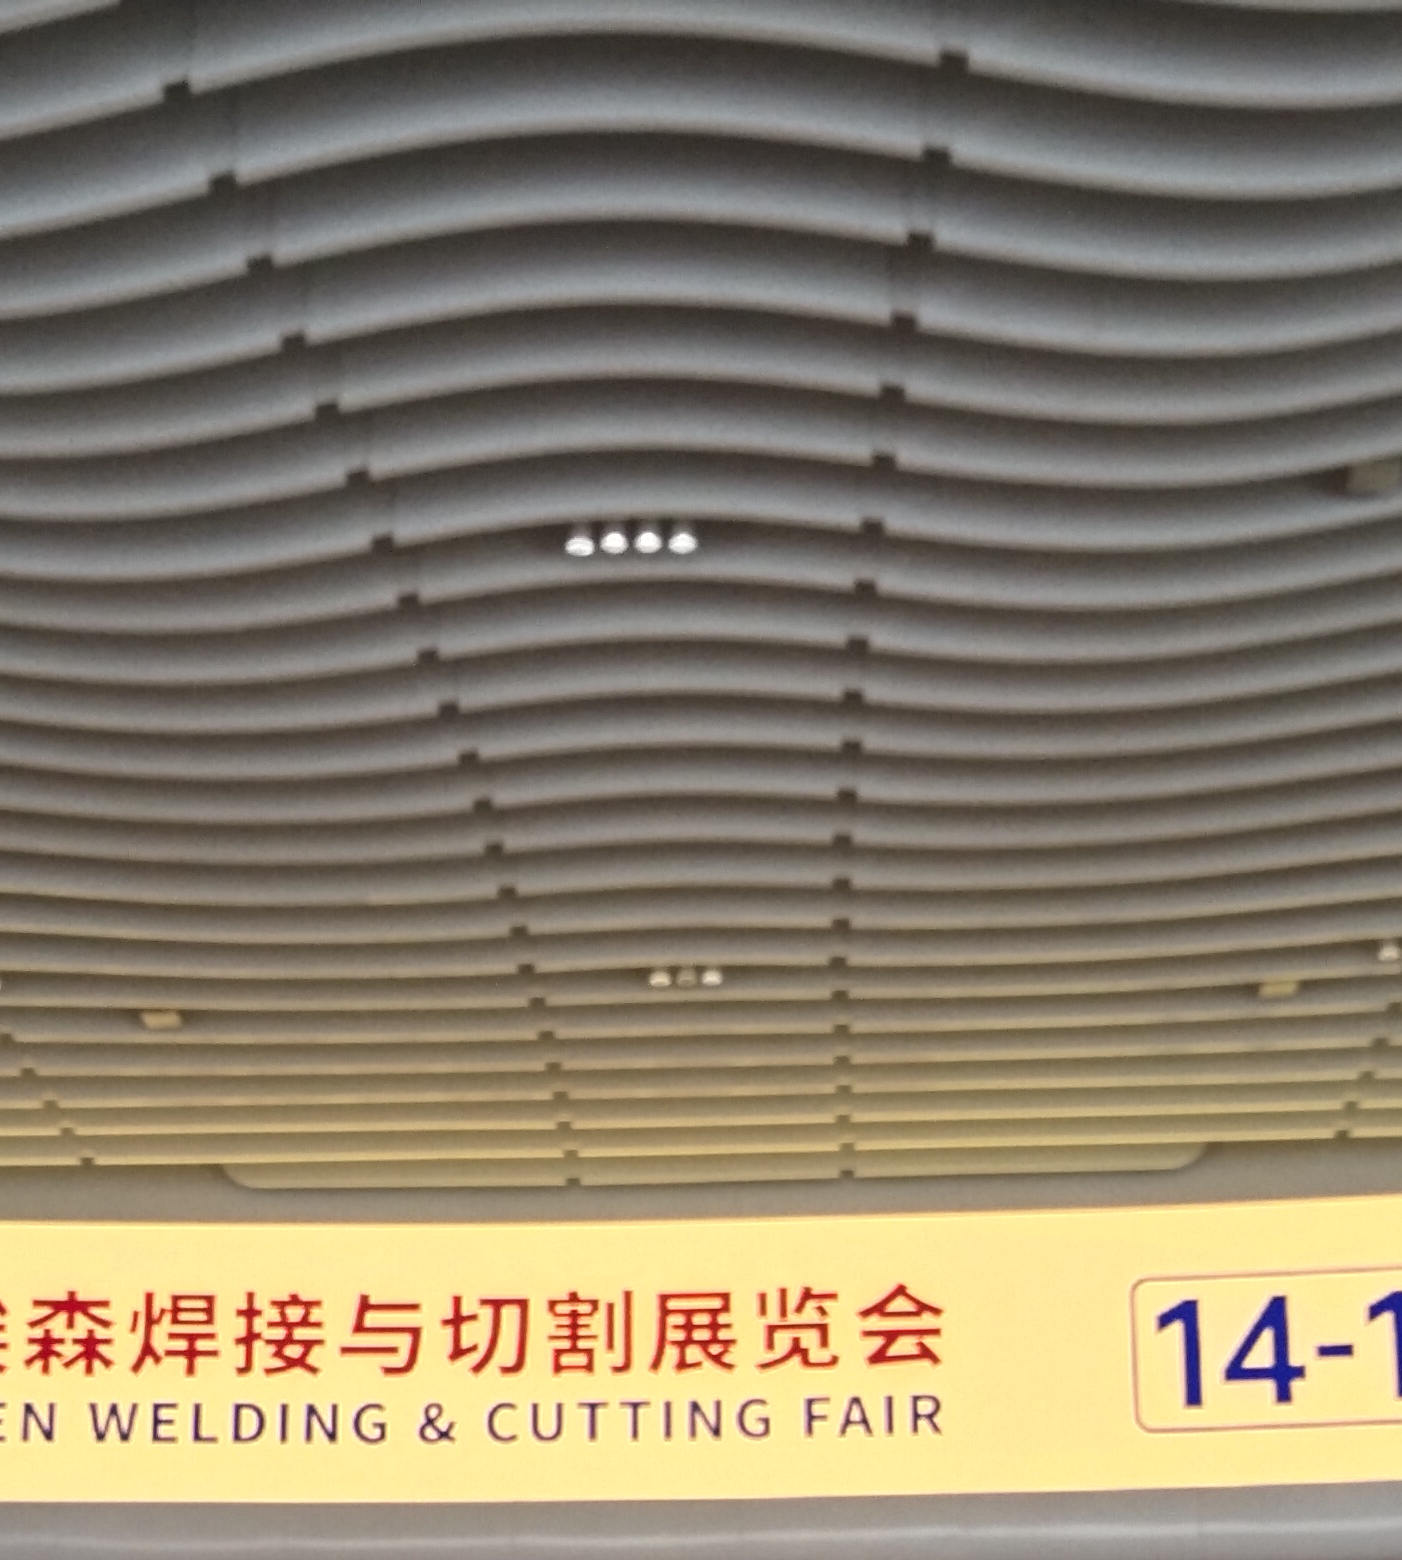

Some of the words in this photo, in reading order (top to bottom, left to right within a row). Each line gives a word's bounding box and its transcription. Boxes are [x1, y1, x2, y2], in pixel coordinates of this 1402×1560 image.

[87, 1401, 388, 1446] WELDING
[417, 1402, 457, 1445] &
[486, 1397, 771, 1445] CUTTING
[803, 1393, 943, 1439] FAIR
